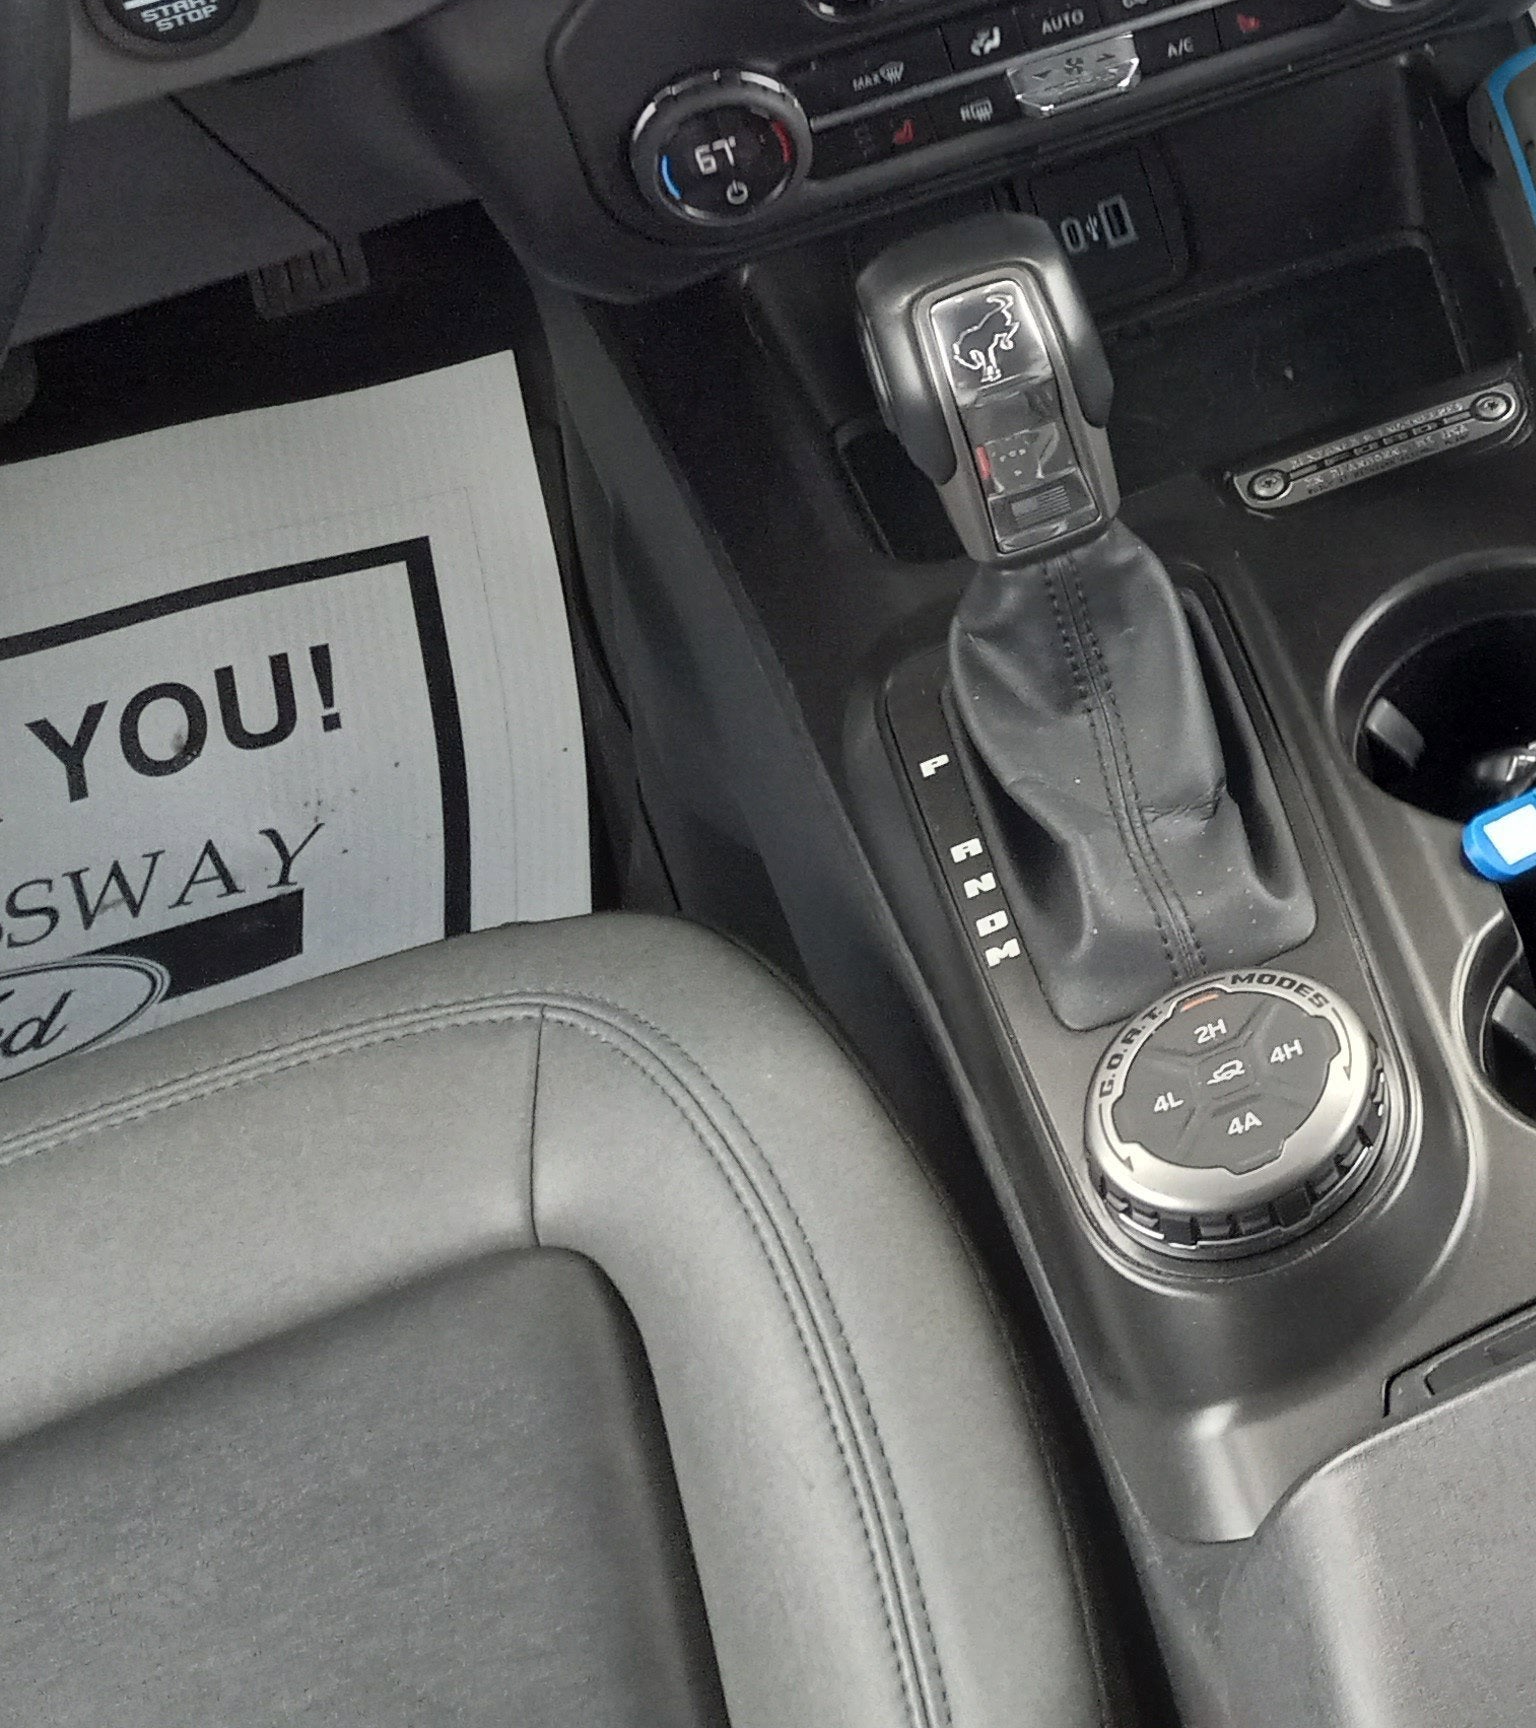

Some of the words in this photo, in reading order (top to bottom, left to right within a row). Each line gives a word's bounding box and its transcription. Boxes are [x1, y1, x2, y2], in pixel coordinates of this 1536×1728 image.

[155, 4, 218, 32] STOP
[1041, 8, 1086, 35] AUTO
[1167, 35, 1195, 58] A/C
[25, 642, 343, 804] YOU!
[919, 754, 949, 777] P
[963, 872, 996, 898] N
[975, 910, 1008, 937] D
[985, 938, 1020, 967] M
[1230, 972, 1328, 1009] MODES
[1194, 1018, 1228, 1044] 2H
[1269, 1039, 1303, 1064] 4H
[1153, 1091, 1184, 1113] 4L
[1227, 1111, 1262, 1137] 4A
